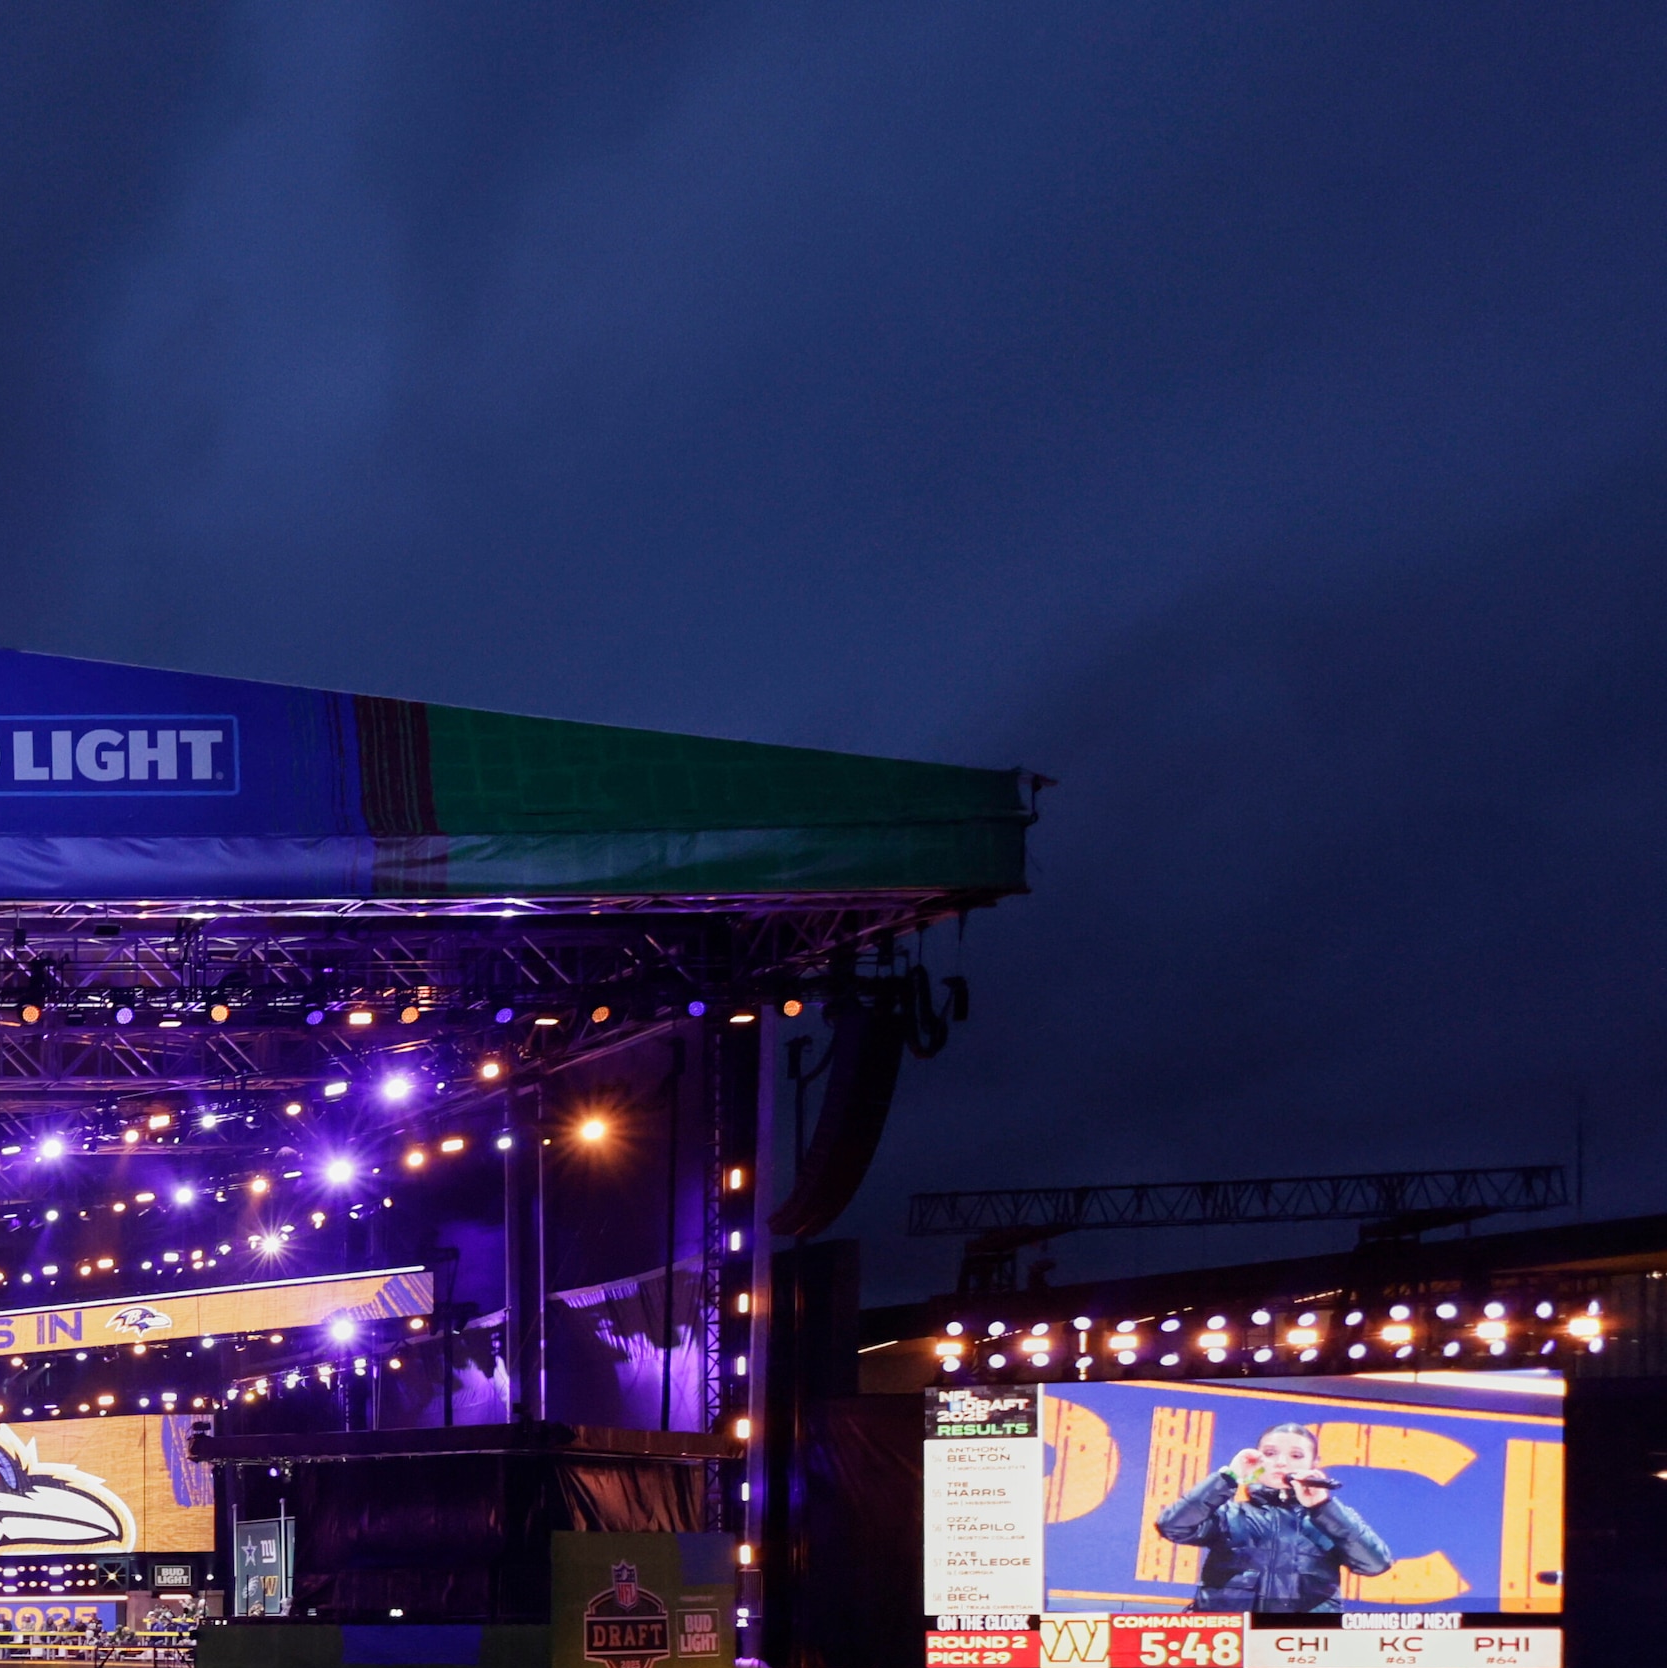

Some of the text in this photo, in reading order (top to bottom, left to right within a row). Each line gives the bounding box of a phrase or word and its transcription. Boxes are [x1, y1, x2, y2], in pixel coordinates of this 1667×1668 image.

[13, 729, 223, 781] LIGHT
[37, 1311, 82, 1345] IN
[939, 1390, 978, 1402] NFL
[963, 1399, 1029, 1411] DRAFT
[937, 1411, 988, 1423] 2025
[937, 1423, 1029, 1436] RESULTS
[947, 1454, 1011, 1462] BELTON
[947, 1489, 1006, 1497] HARRIS
[947, 1523, 1016, 1531] TRAPILO
[947, 1558, 1032, 1566] RATLEDGE
[160, 1566, 186, 1575] BUD
[156, 1575, 190, 1586] LIGHT
[947, 1593, 990, 1601] BECH
[684, 1614, 713, 1633] BUD
[937, 1616, 1030, 1630] ON THE CLOCK
[1113, 1615, 1242, 1628] COMMANDERS
[1342, 1612, 1462, 1630] COMING UP NEXT
[592, 1624, 663, 1647] DRAFT
[680, 1633, 718, 1652] LIGHT
[927, 1636, 1028, 1648] ROUND 2
[1275, 1637, 1329, 1652] CHI
[1379, 1637, 1424, 1652] KC
[1474, 1637, 1530, 1652] PHI
[1140, 1632, 1241, 1666] 5:48
[927, 1652, 1012, 1665] PICK 29
[1287, 1656, 1317, 1664] #62
[1386, 1656, 1417, 1664] #63
[1486, 1656, 1518, 1664] #64
